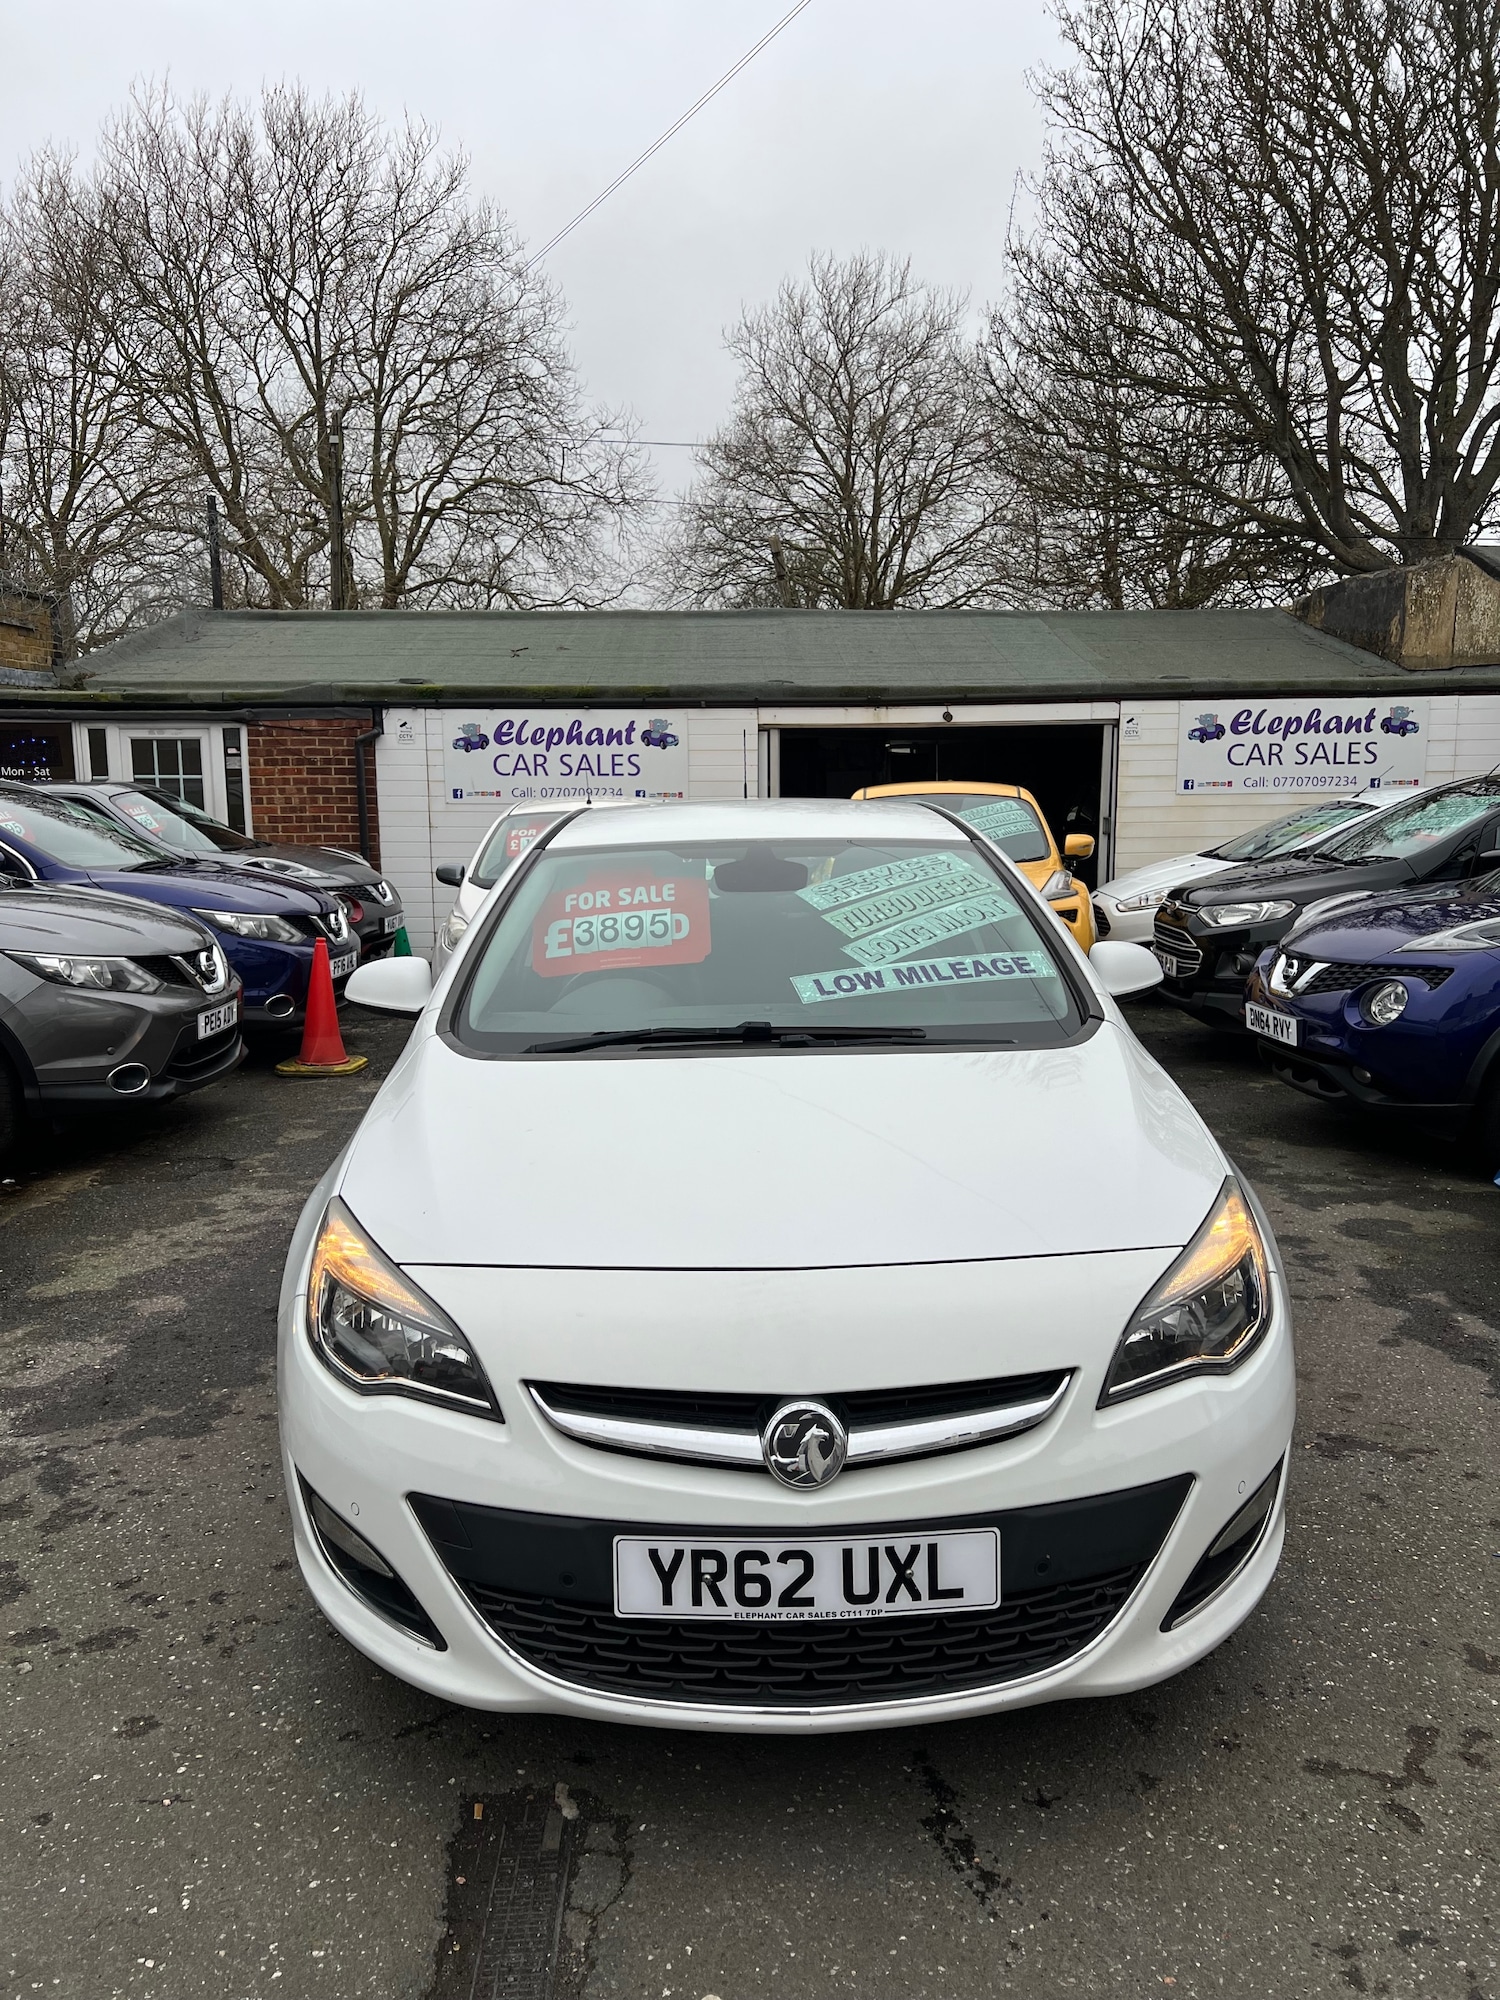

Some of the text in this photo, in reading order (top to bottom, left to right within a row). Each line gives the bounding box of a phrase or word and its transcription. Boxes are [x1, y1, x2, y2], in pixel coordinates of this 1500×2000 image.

[493, 719, 636, 752] Elephant
[1230, 707, 1376, 741] Elephant
[493, 753, 641, 777] CAR SALES
[1227, 741, 1378, 766] CAR SALES
[1, 766, 25, 776] Mon
[34, 766, 51, 776] Sat
[1243, 777, 1269, 788] Call:
[1273, 776, 1358, 788] 07707097234
[511, 787, 537, 798] Call:
[511, 829, 537, 837] FOR
[810, 855, 947, 895] SERVICE
[820, 861, 954, 904] HISTORY
[565, 883, 675, 913] FOR SALE
[850, 921, 936, 964] LONG
[812, 955, 1037, 997] LOW MILEAGE
[1249, 1007, 1271, 1033] DN64
[1272, 1015, 1291, 1040] RVY
[648, 1542, 964, 1608] YR62 UXL
[734, 1612, 783, 1620] ELEPHANT
[786, 1612, 805, 1620] CAR
[807, 1611, 837, 1619] SALES
[839, 1610, 862, 1618] CT11
